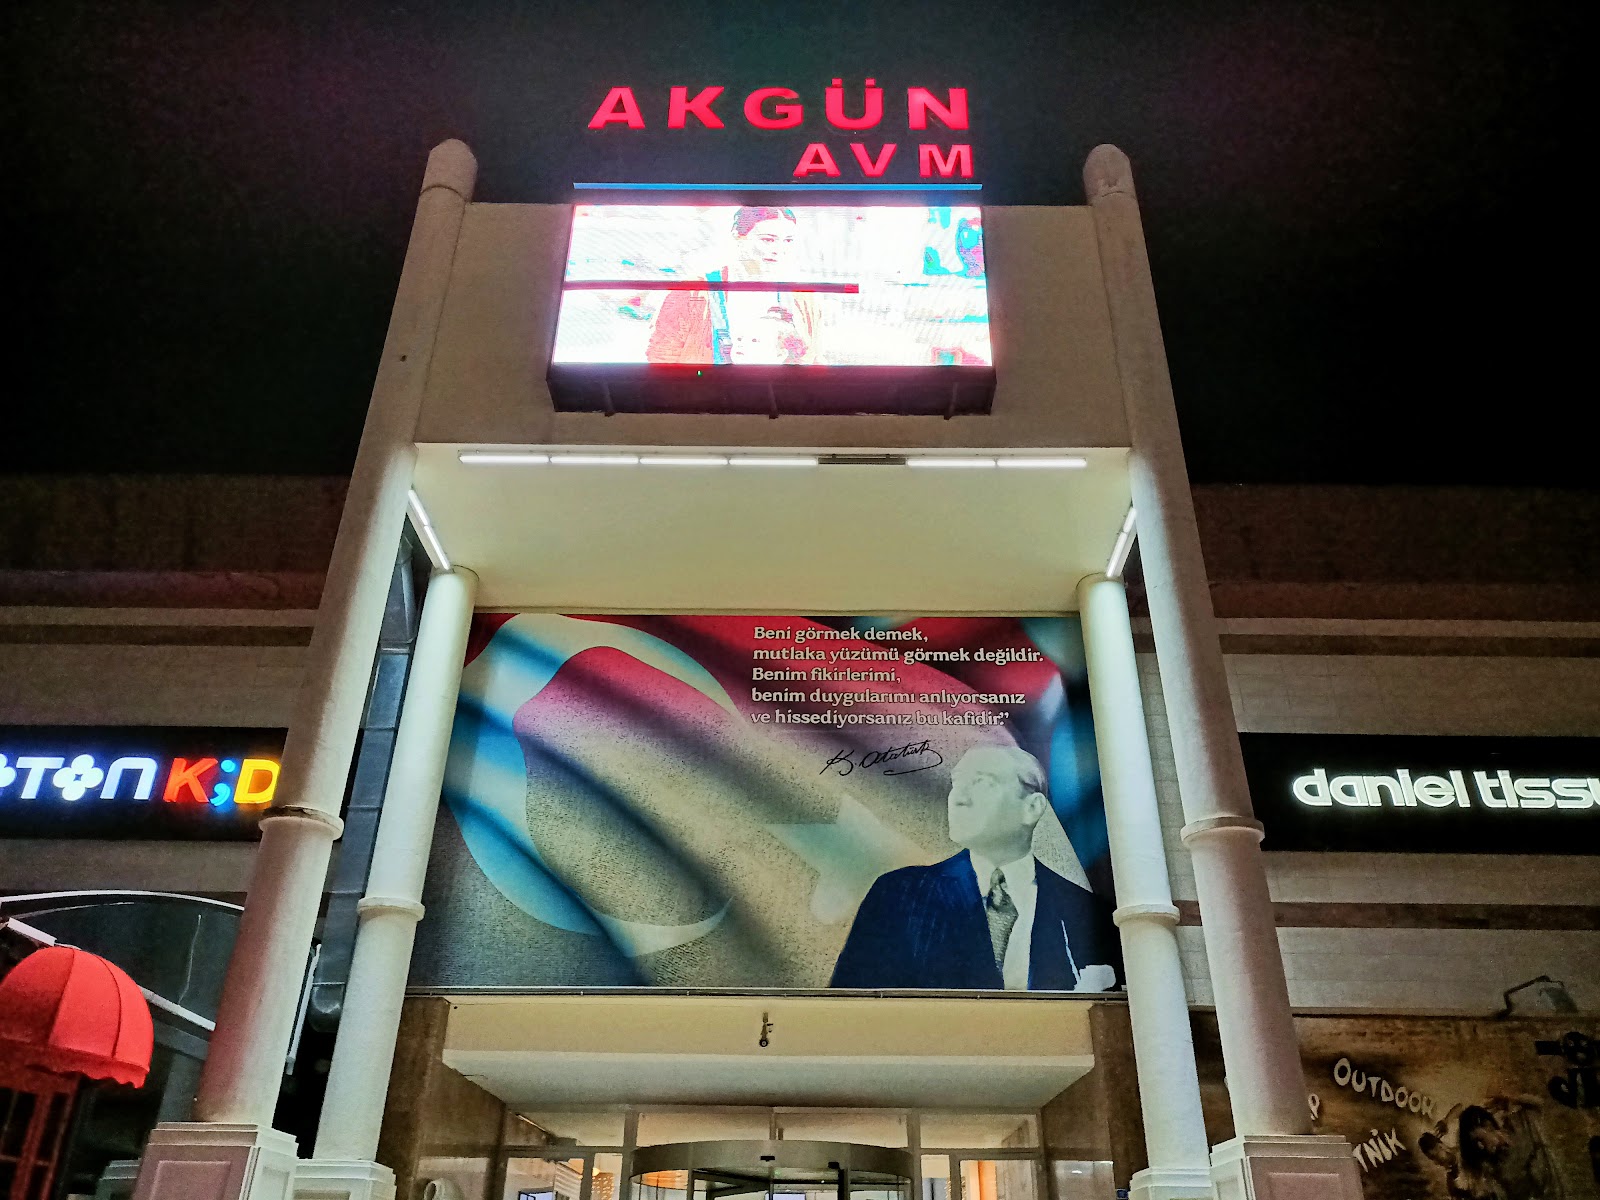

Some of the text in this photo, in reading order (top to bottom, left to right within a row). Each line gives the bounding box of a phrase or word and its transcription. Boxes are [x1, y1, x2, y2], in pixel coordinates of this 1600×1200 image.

[588, 78, 970, 131] AKGÜN
[793, 142, 974, 178] AVM
[753, 626, 928, 644] Beni görmek demek,
[752, 646, 1044, 666] mutlaka yüzümü görmek değildir.
[751, 667, 901, 683] Benim fikirlerimi,
[751, 687, 1026, 708] benim duygularımı anlıyorsanız
[750, 712, 771, 724] ve
[774, 709, 912, 728] hissediyorsanız
[915, 710, 939, 725] bu
[1292, 769, 1471, 808] daniel
[1334, 1057, 1434, 1118] OUTDOOR
[1352, 1128, 1406, 1173] TNİK
